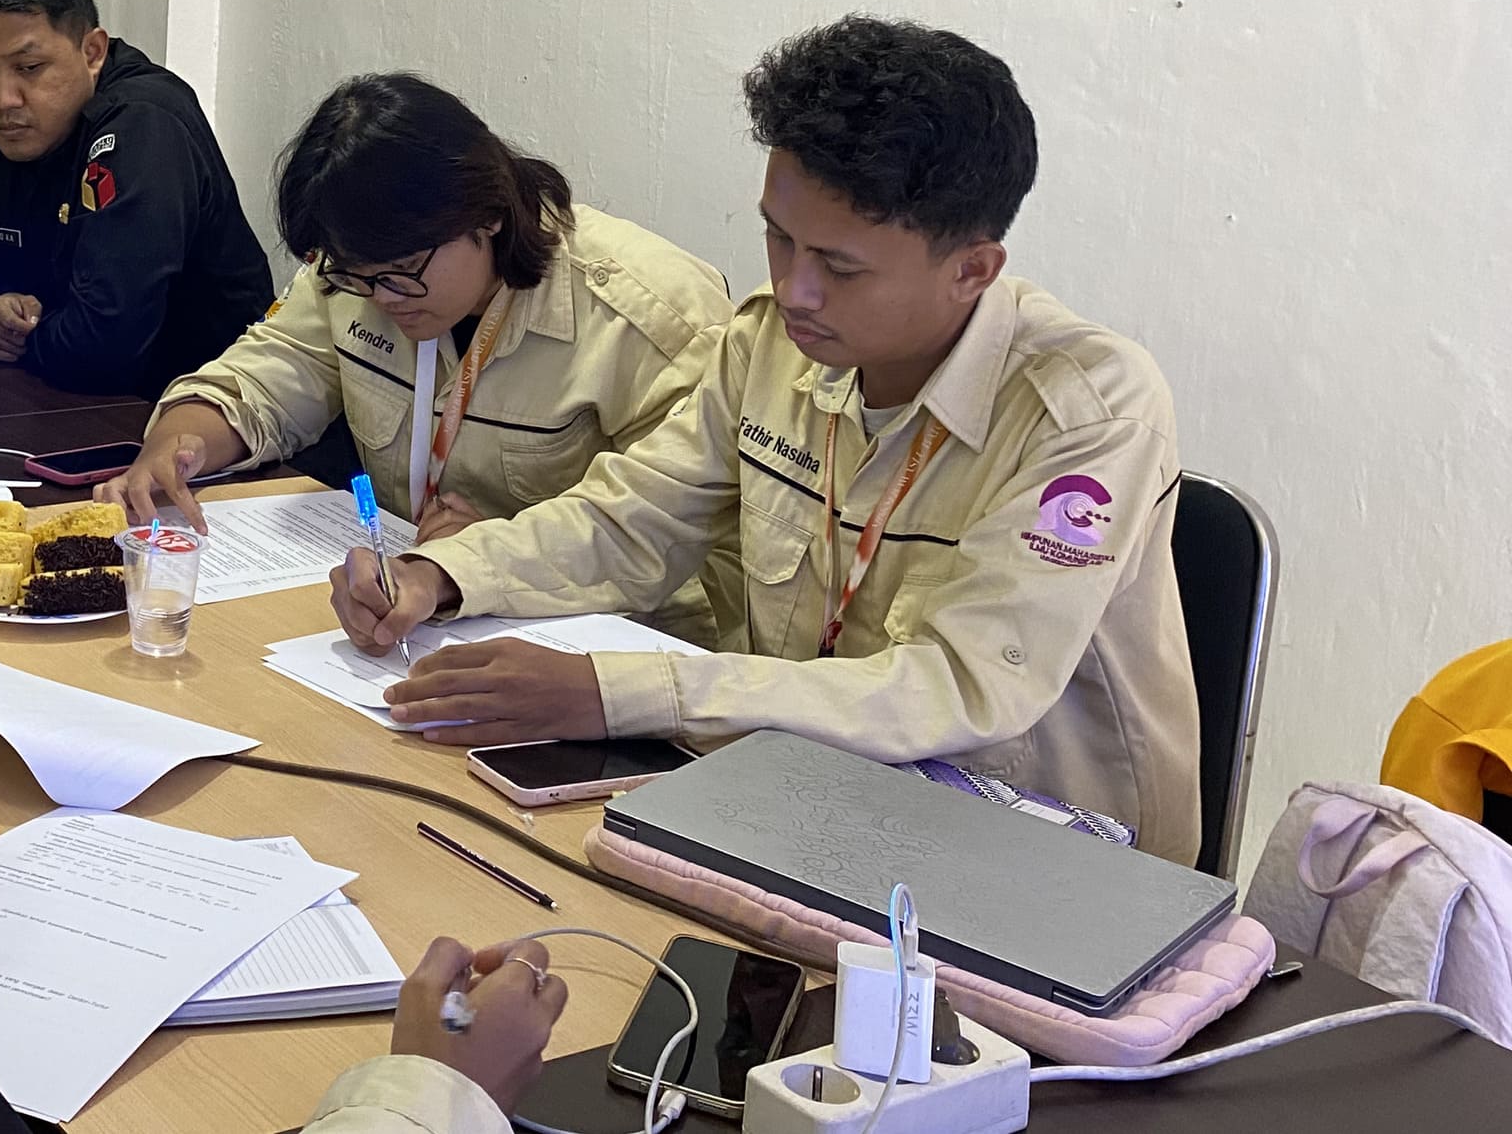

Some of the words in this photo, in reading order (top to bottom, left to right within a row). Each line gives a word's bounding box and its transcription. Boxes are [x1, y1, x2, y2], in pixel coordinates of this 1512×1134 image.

[347, 320, 395, 355] Kendra
[738, 416, 774, 448] Fathir
[772, 435, 820, 474] Nasuha
